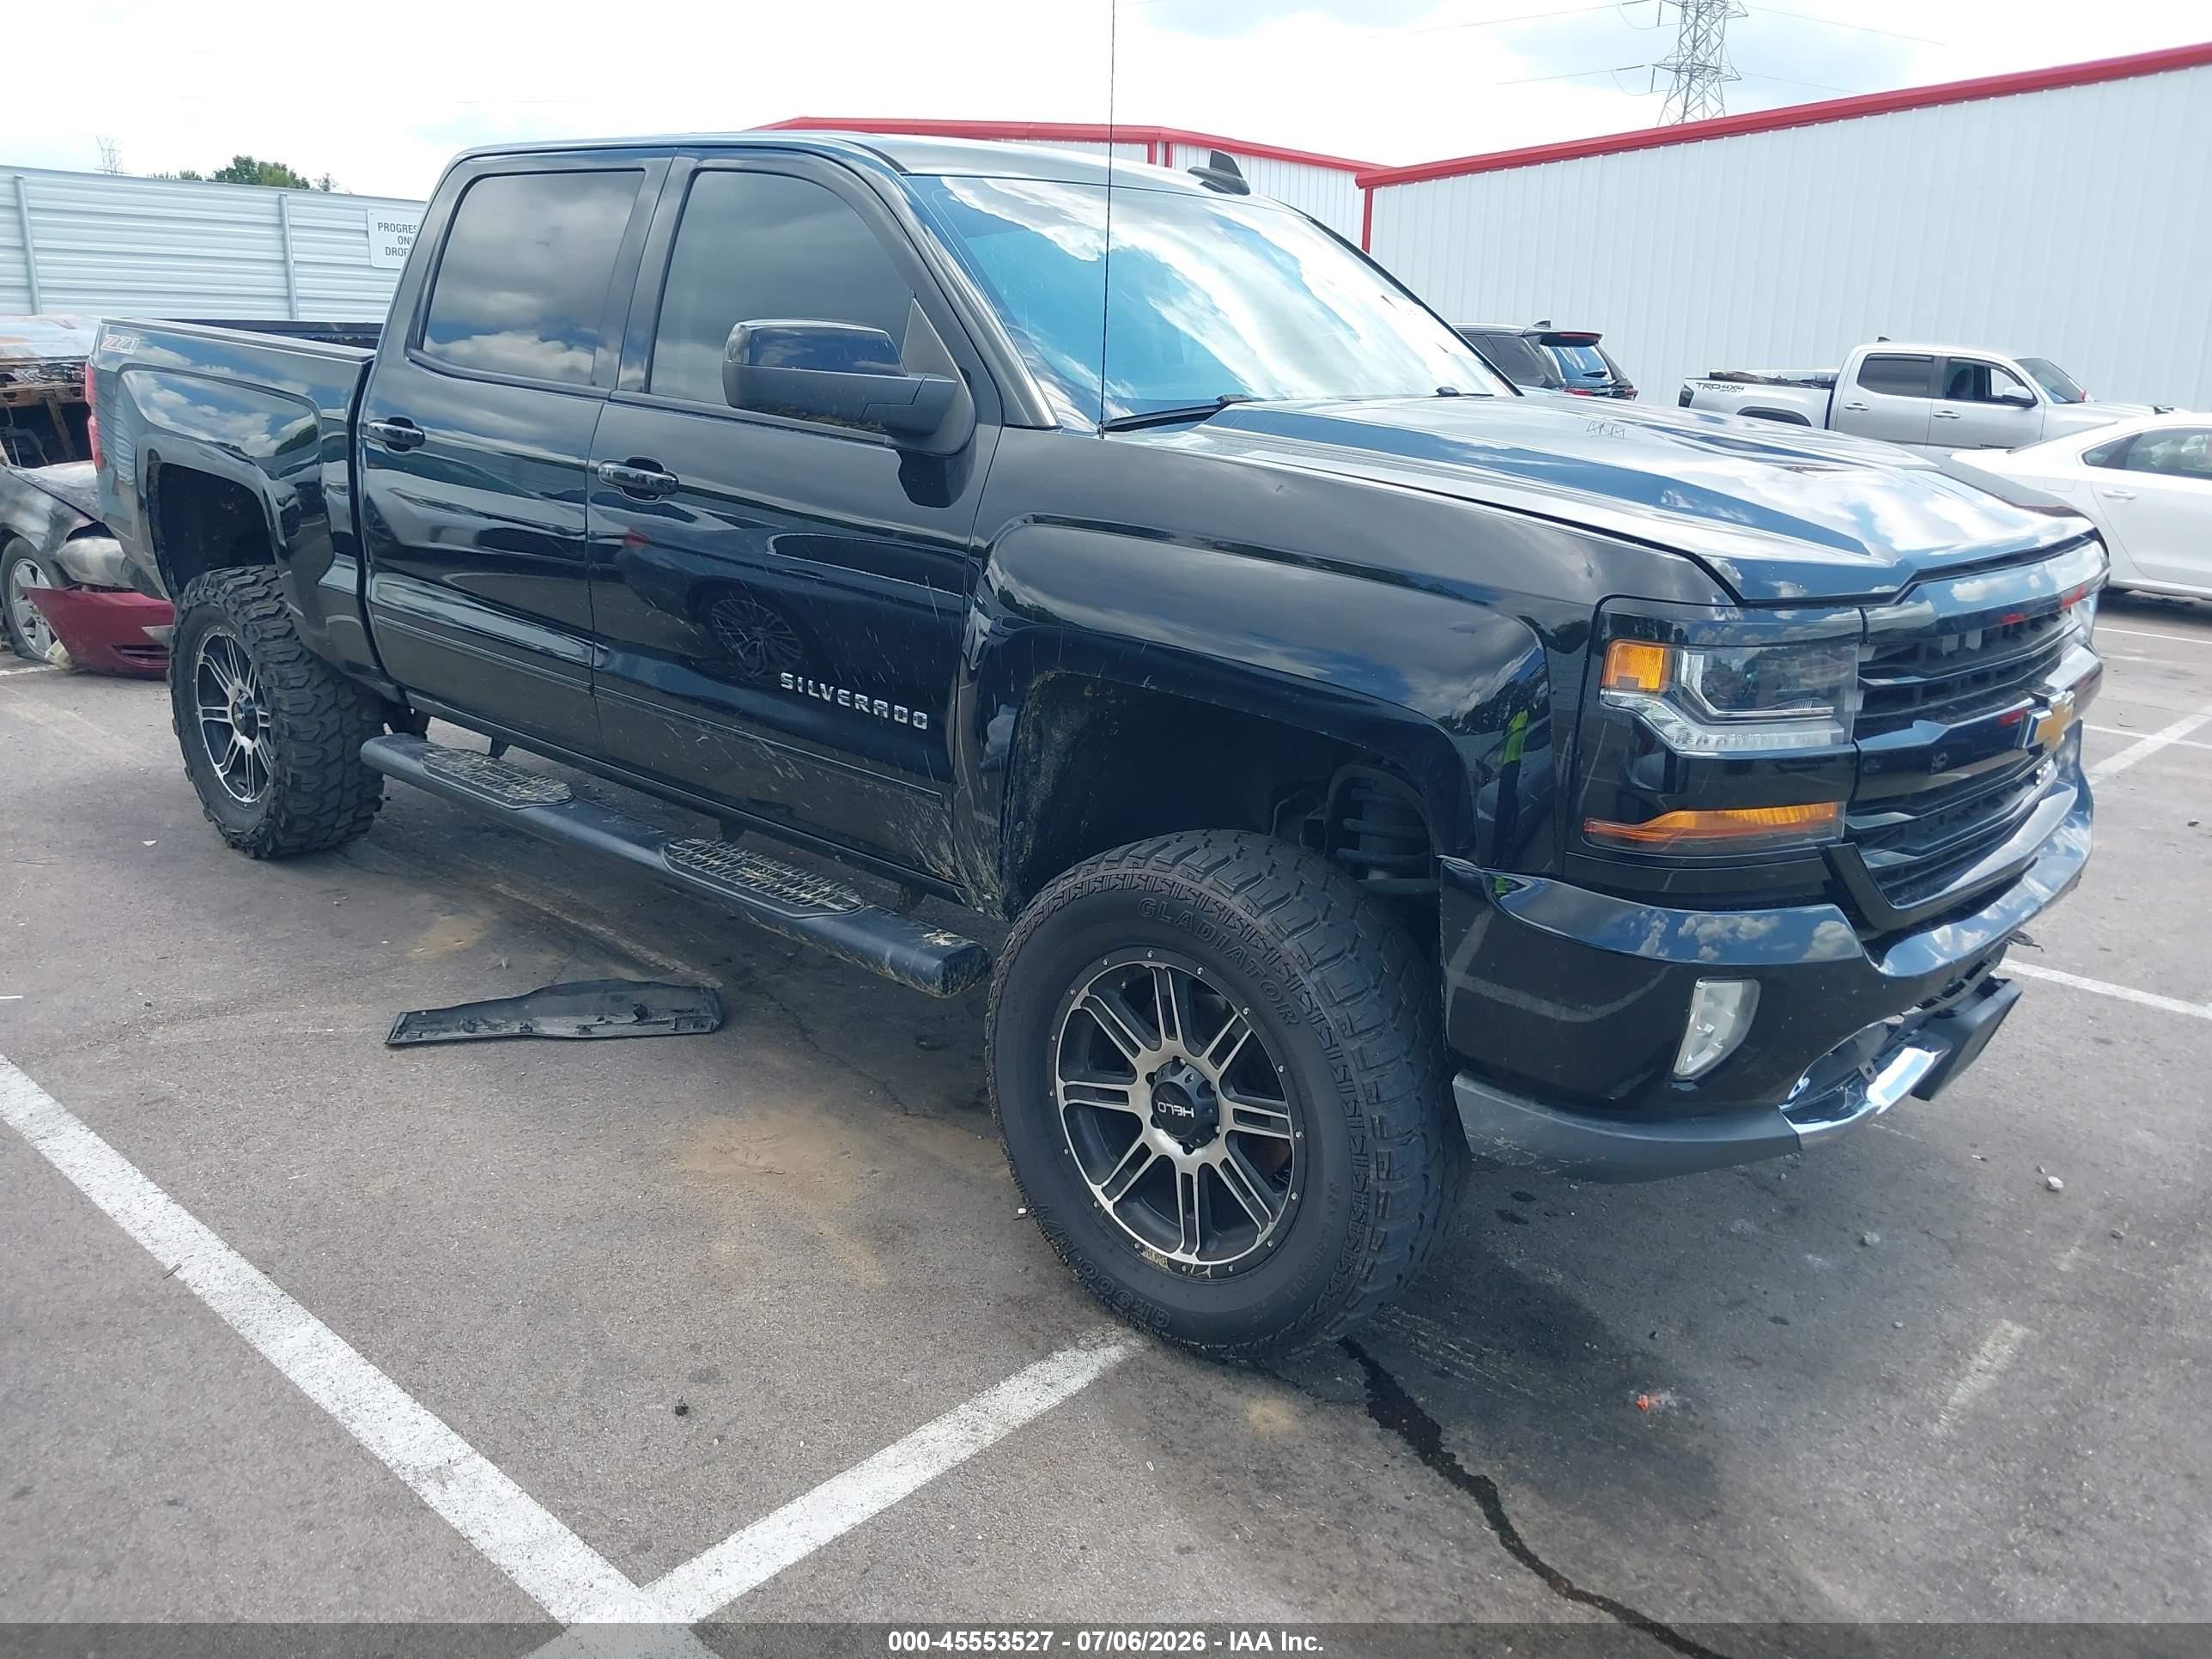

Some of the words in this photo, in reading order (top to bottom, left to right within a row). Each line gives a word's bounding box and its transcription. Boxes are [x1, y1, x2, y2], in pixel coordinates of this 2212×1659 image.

[100, 334, 140, 356] Z71
[1695, 382, 1721, 391] TRD
[780, 672, 928, 731] SILVERADO
[1139, 896, 1301, 1025] GLADIATOR
[1157, 1101, 1195, 1119] HELO
